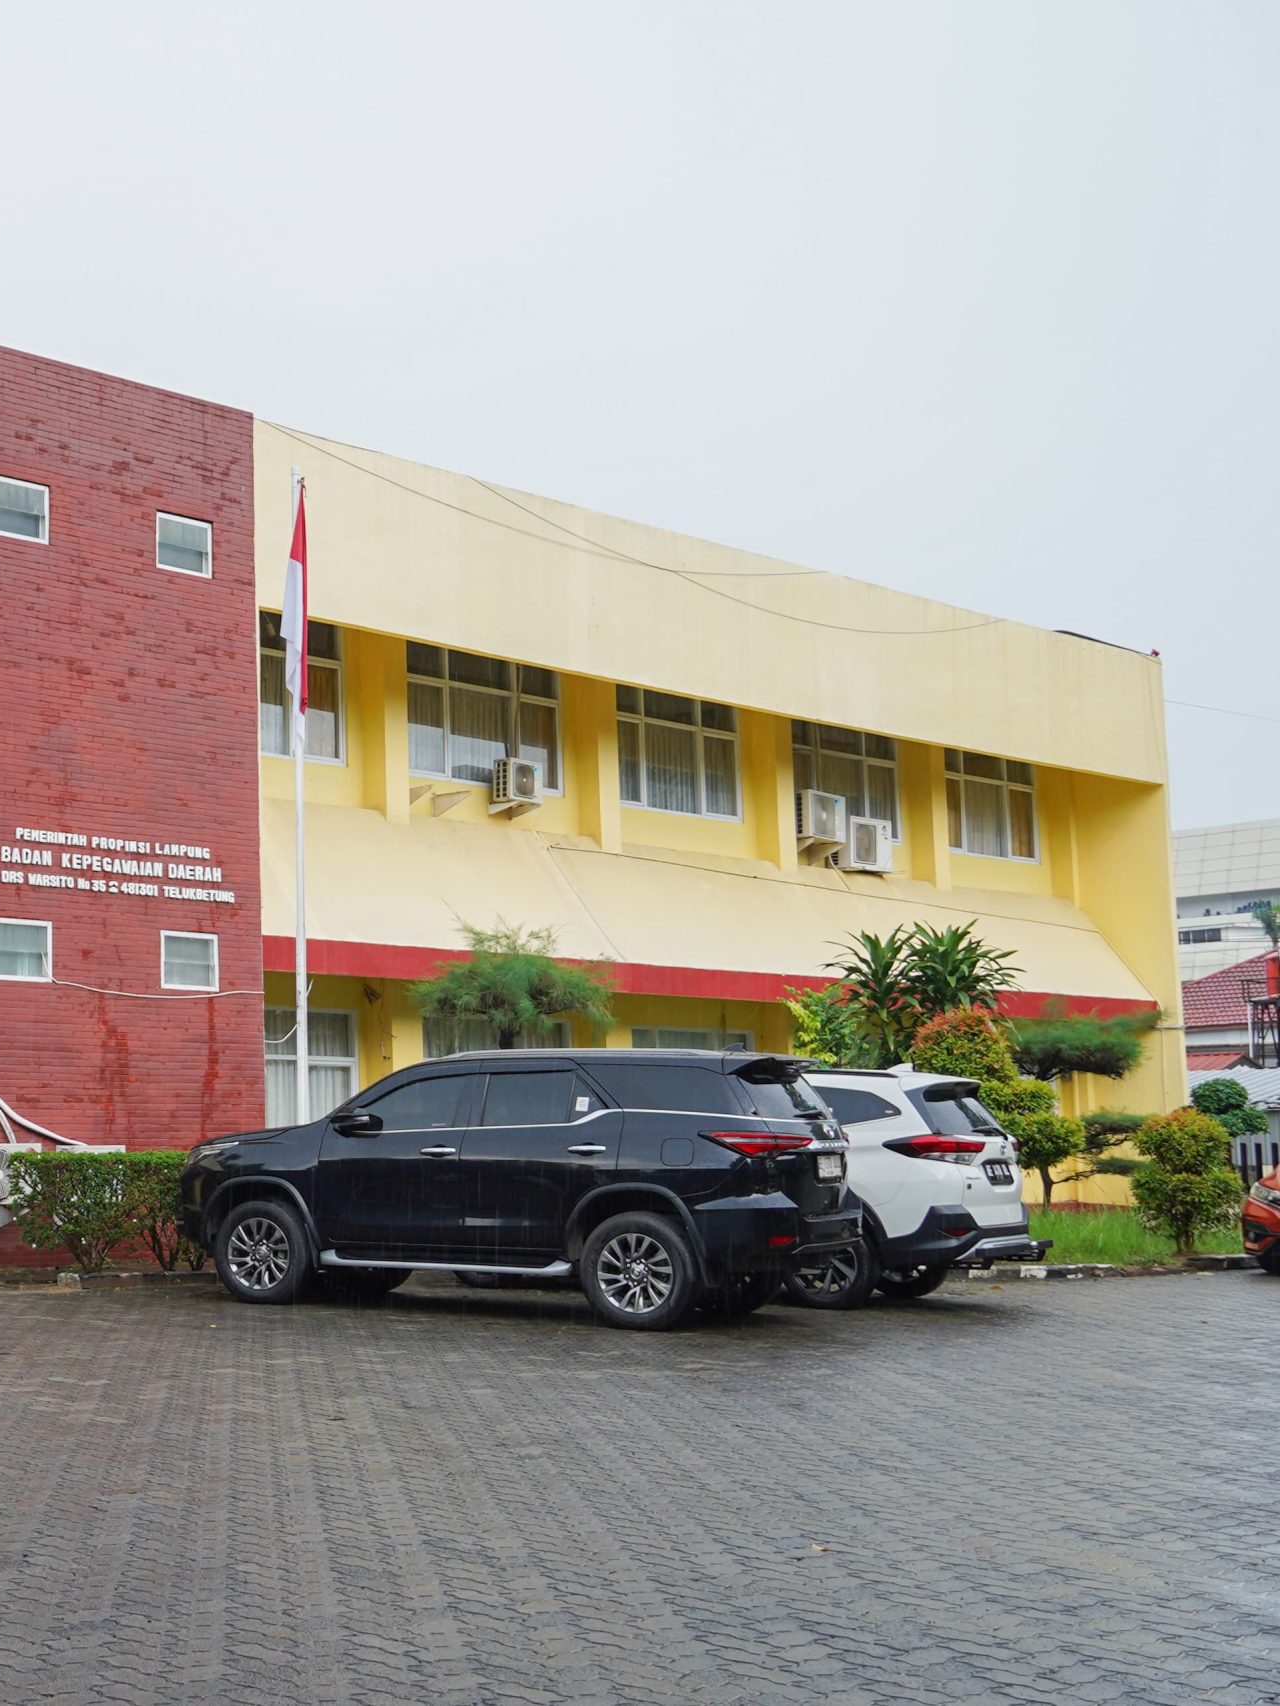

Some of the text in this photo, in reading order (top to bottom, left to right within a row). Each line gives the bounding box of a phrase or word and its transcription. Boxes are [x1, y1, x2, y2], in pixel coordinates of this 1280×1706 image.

[15, 827, 211, 860] PEMERINTAH PROPINSI LAMPUNG
[0, 846, 222, 882] BADAN KEPEGAWAIAN DAERAH
[1, 870, 24, 884] DRS
[28, 872, 75, 888] WARSITO
[91, 879, 107, 892] 35
[120, 882, 159, 897] 481301
[162, 885, 235, 904] TELUKBETUNG
